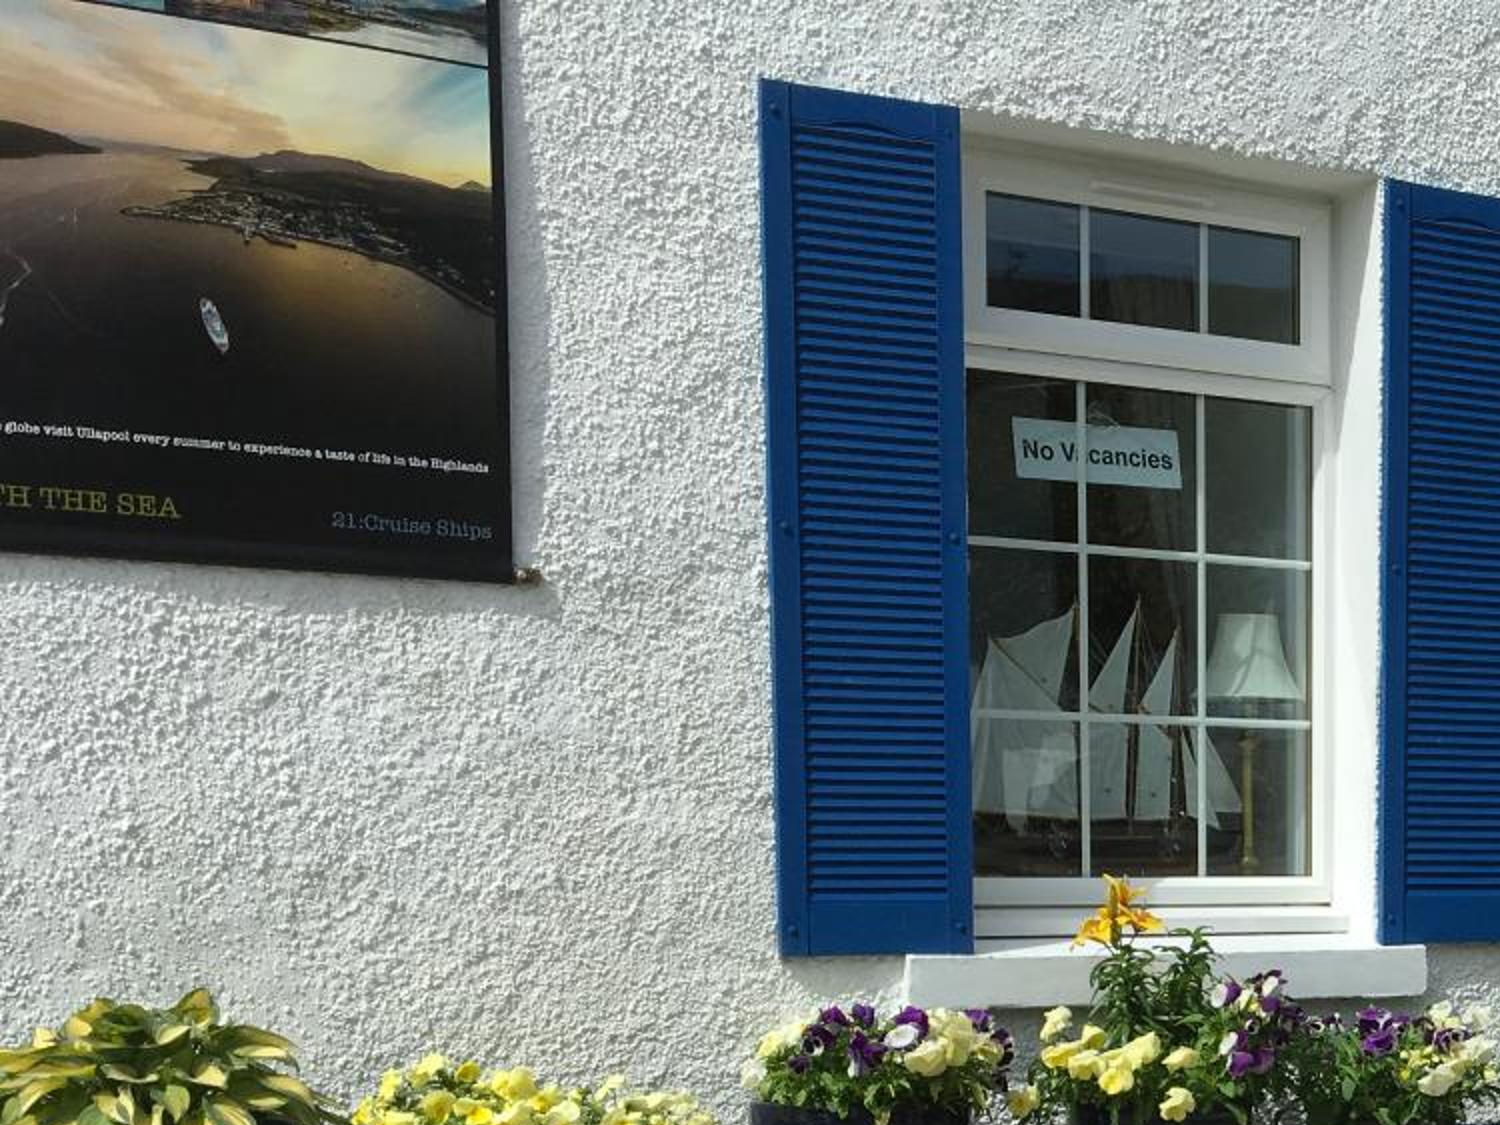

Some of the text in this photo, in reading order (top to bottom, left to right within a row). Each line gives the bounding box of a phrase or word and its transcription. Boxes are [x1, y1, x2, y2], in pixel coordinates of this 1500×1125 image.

[4, 421, 41, 435] globe
[42, 424, 74, 438] visit
[77, 427, 130, 442] Ullapool
[133, 434, 171, 447] every
[228, 440, 241, 451] to
[243, 442, 313, 458] experience
[314, 449, 323, 459] a
[325, 448, 355, 462] taste
[358, 451, 372, 463] of
[408, 454, 429, 468] the
[431, 457, 489, 474] Highlands
[1021, 438, 1174, 471] No Vcancies
[39, 487, 108, 514] THE
[116, 492, 183, 519] SEA
[435, 518, 493, 541] Ships
